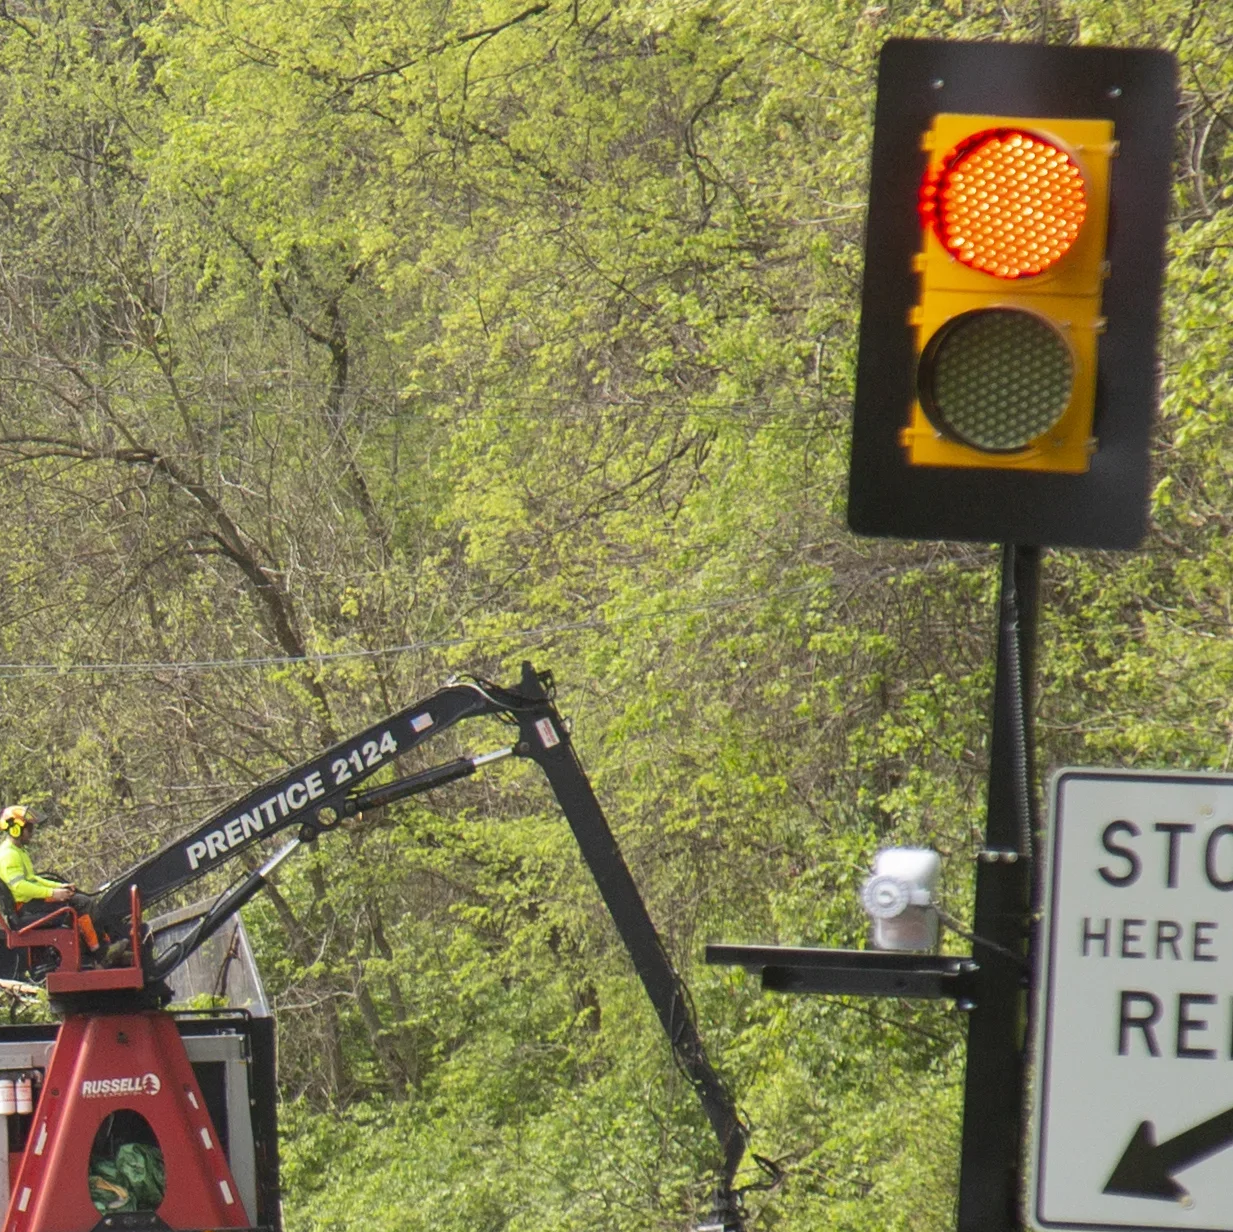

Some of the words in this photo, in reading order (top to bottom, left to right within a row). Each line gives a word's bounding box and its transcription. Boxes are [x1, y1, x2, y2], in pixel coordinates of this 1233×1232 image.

[186, 771, 325, 870] PRENTICE
[331, 731, 397, 785] 2124
[1081, 917, 1219, 962] HERE
[1117, 991, 1233, 1060] RE
[82, 1077, 143, 1096] RUSSELL
